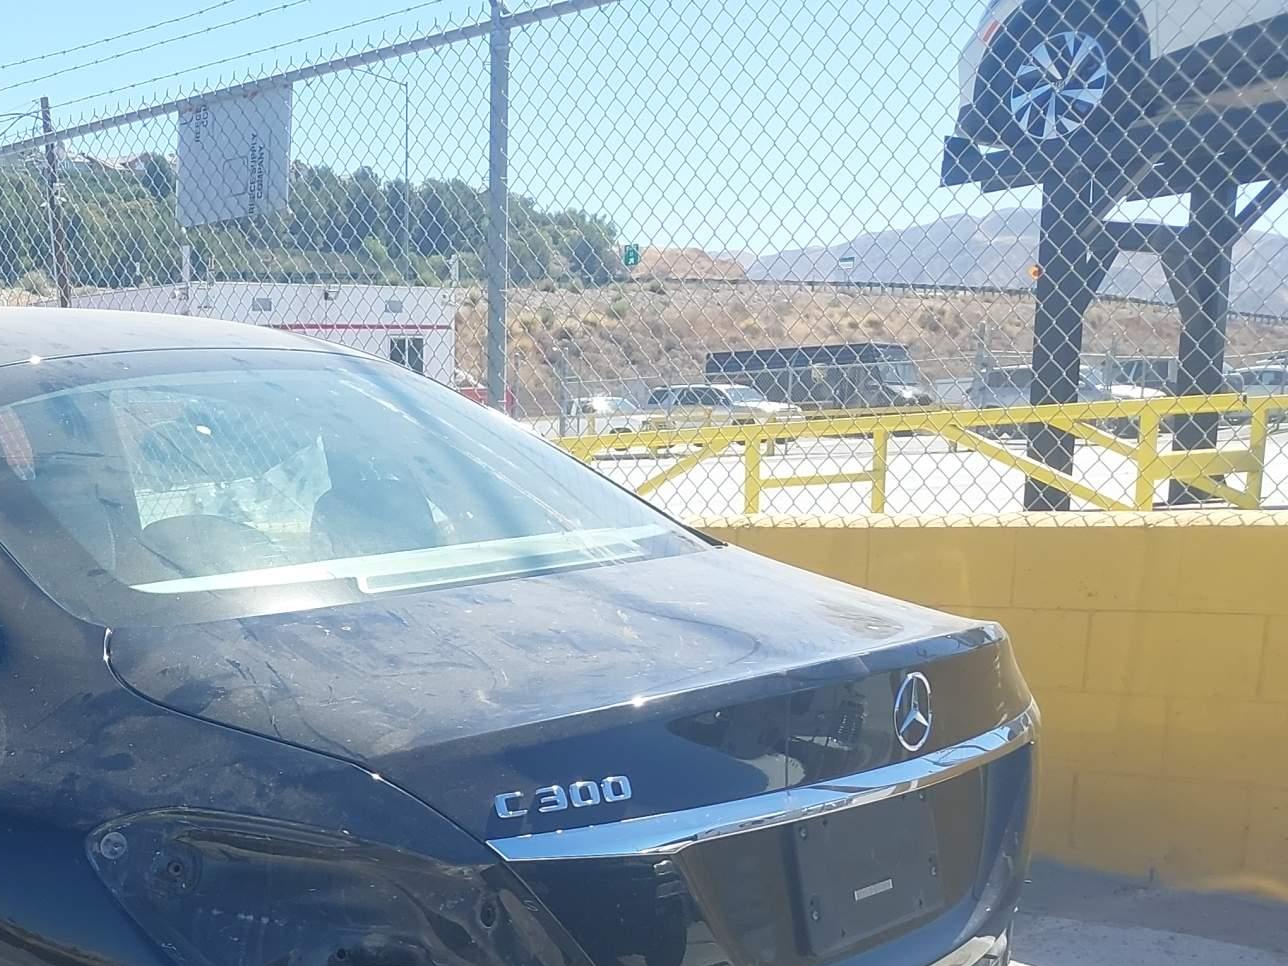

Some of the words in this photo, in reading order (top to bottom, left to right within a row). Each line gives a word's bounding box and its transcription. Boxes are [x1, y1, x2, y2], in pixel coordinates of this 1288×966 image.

[249, 133, 257, 175] SUPPLY
[256, 145, 264, 200] COMPANY
[494, 791, 528, 819] C
[535, 775, 632, 813] 300
